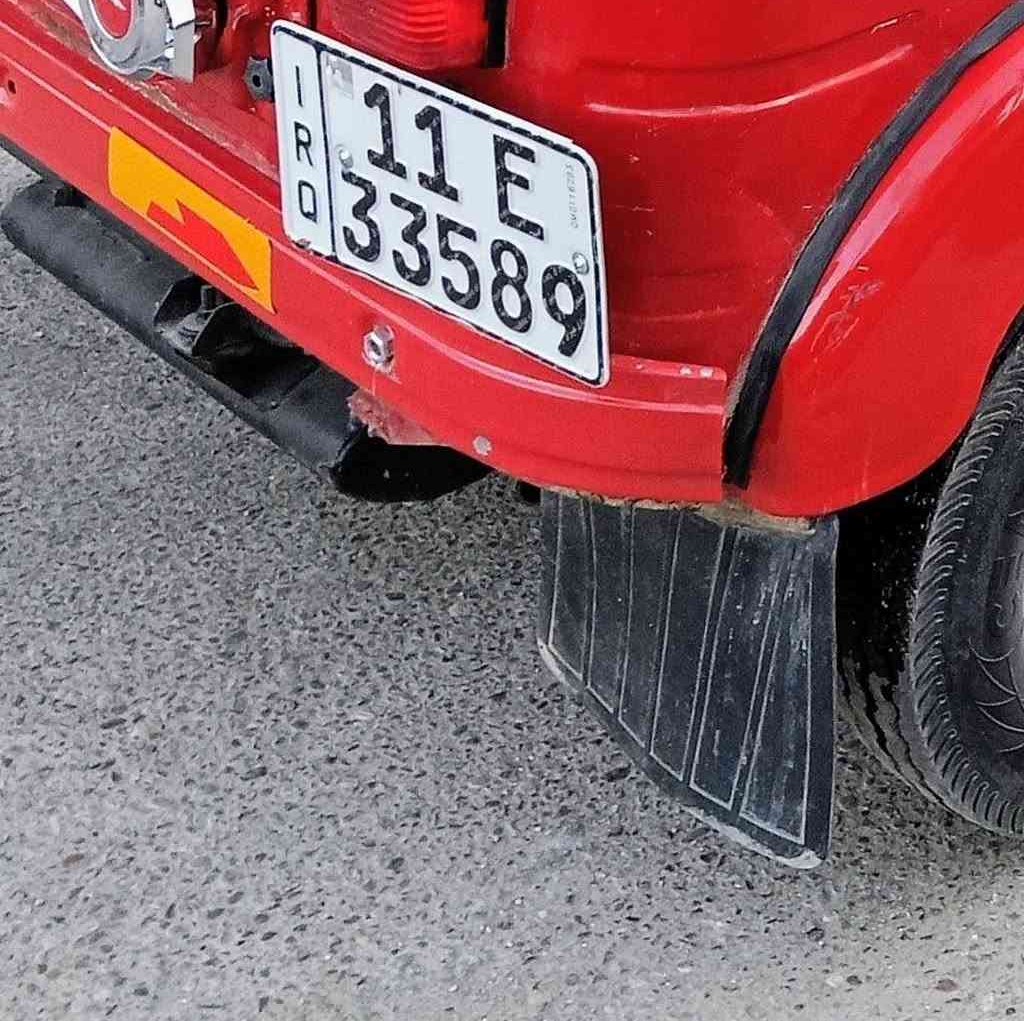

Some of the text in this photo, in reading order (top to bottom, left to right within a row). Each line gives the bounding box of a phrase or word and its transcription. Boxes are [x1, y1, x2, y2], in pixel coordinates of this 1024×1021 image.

[293, 65, 318, 223] IRQ
[363, 83, 460, 202] 11
[492, 134, 545, 240] E
[341, 171, 586, 357] 33589
